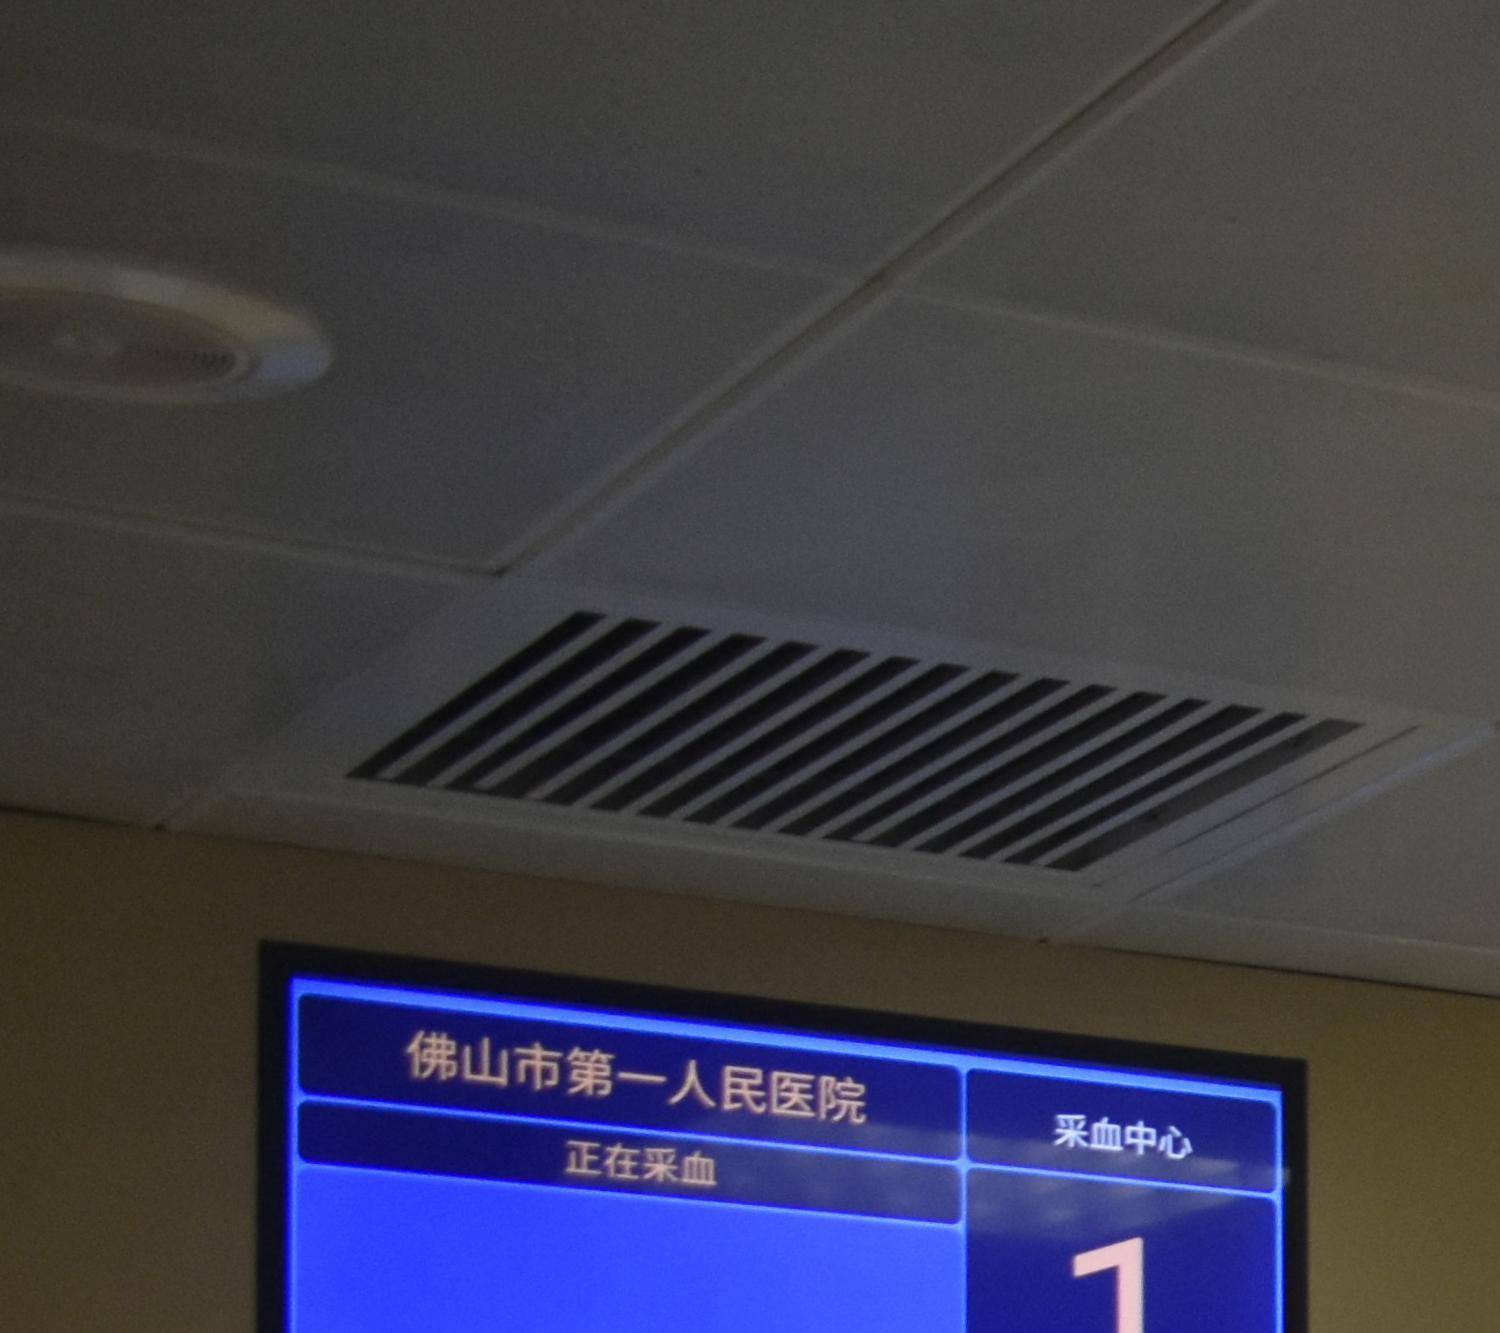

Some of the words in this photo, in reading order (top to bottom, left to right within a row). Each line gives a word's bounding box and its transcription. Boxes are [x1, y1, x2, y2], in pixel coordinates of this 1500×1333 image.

[405, 1030, 868, 1126] 佛山市第一人民医院
[1053, 1113, 1194, 1159] 采血中心
[564, 1140, 717, 1187] 正在采血
